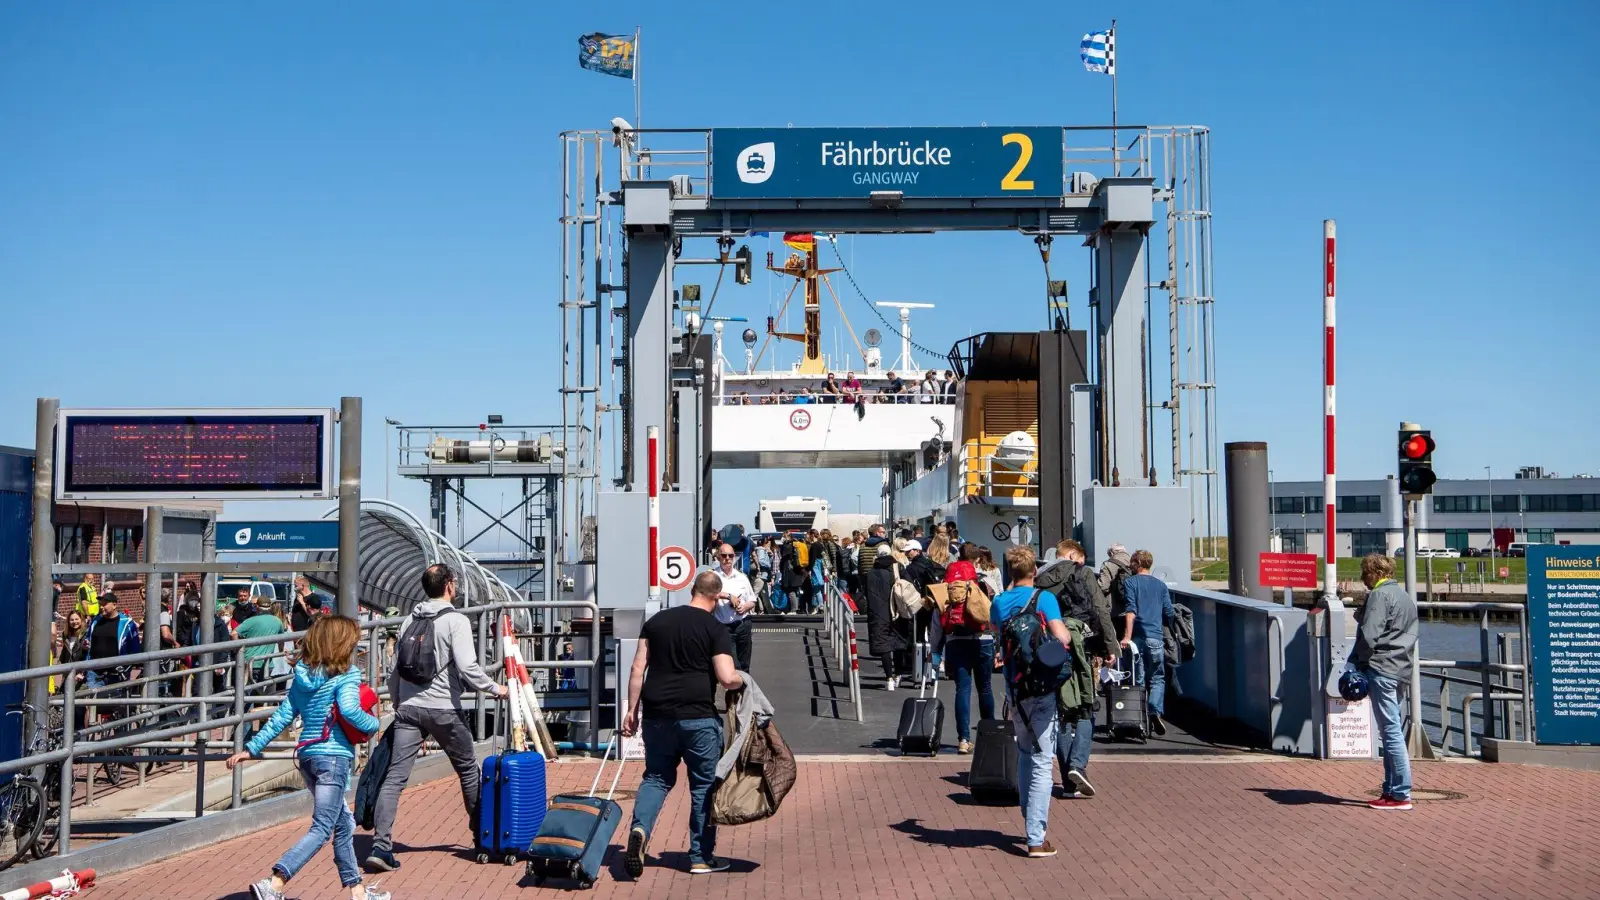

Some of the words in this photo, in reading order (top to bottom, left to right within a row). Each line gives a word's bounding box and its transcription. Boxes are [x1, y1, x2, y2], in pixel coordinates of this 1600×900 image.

[821, 141, 952, 166] Fährbrücke
[1001, 133, 1035, 190] 2
[852, 171, 920, 185] GANGWAY
[256, 532, 286, 540] Ankunft
[666, 556, 682, 579] 5
[1546, 556, 1592, 568] Hinweise
